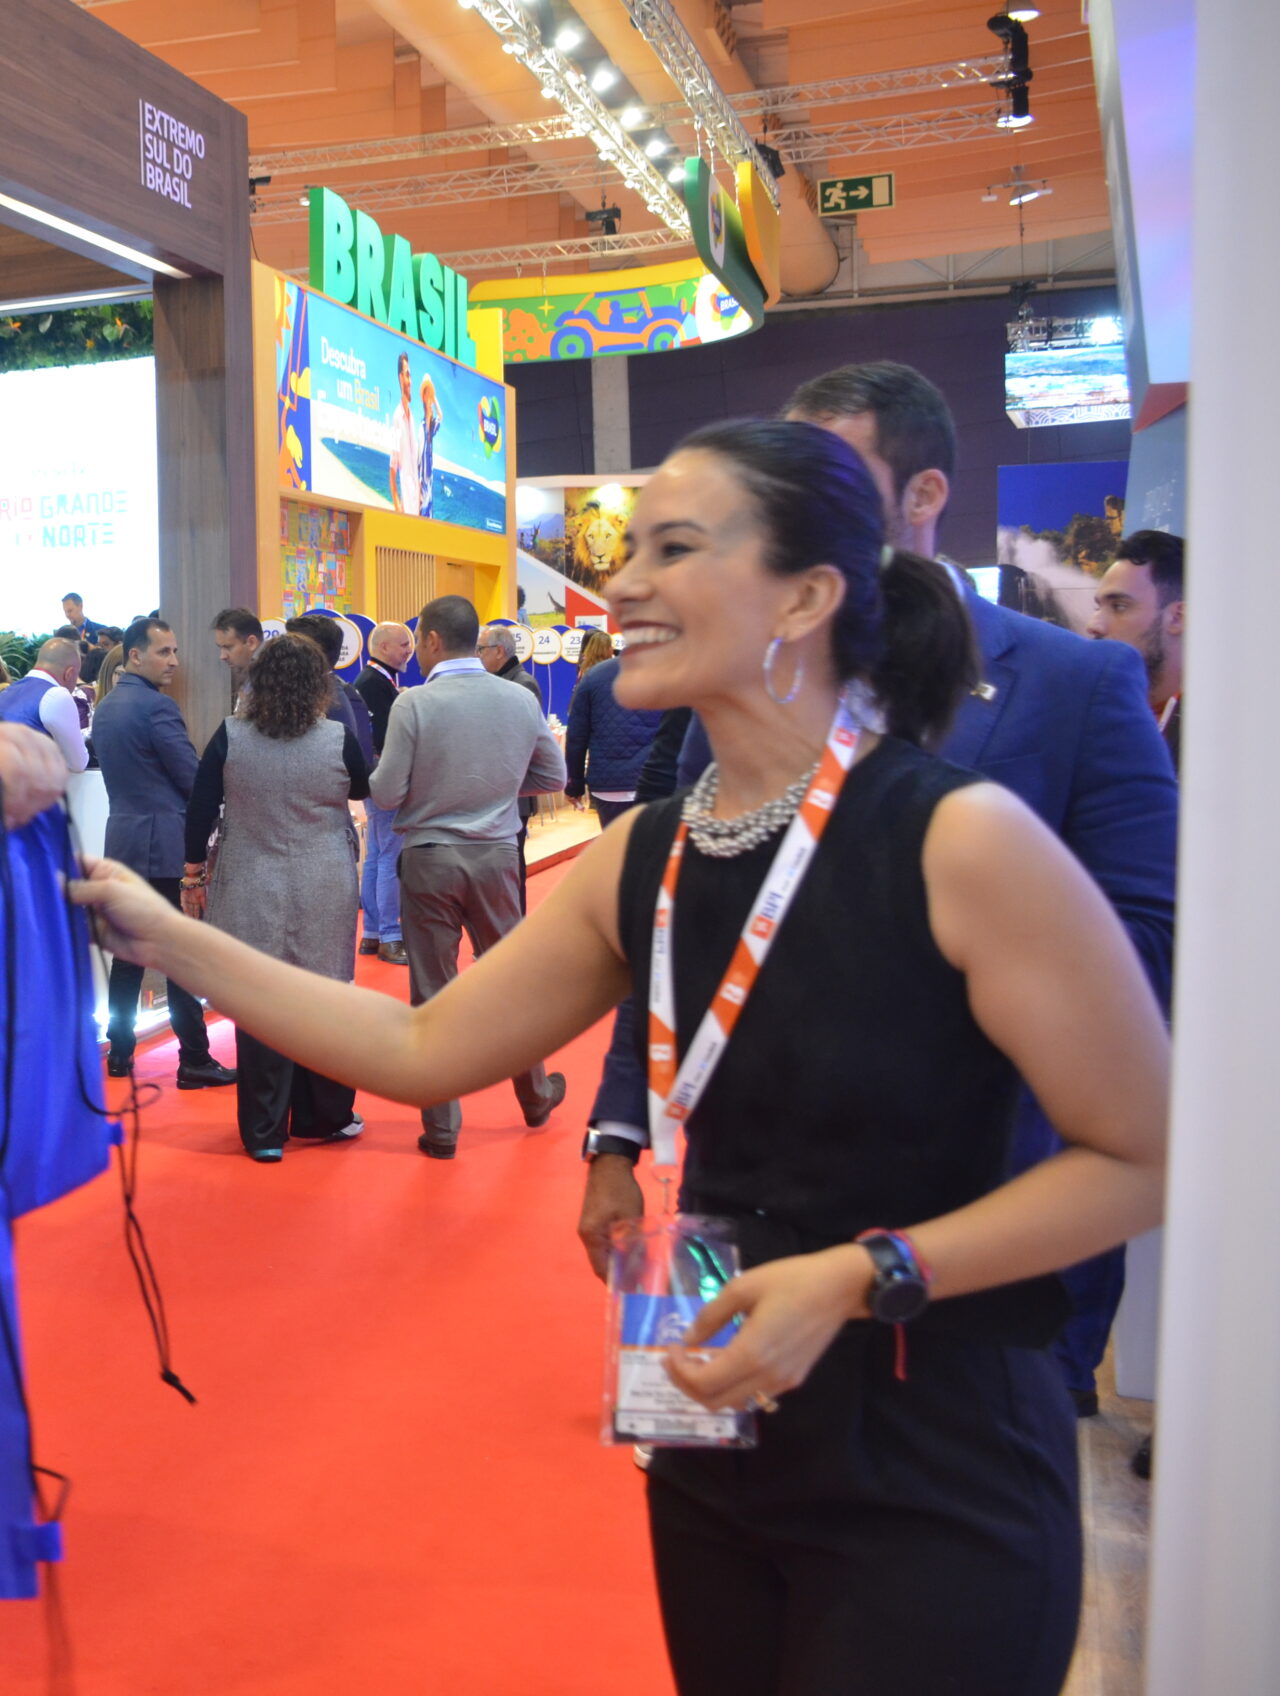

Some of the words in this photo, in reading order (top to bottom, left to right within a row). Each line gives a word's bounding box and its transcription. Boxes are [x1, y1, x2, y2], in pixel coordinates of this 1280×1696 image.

[144, 101, 206, 160] EXTREMO
[145, 132, 171, 170] SUL
[173, 147, 192, 180] DO
[146, 161, 192, 209] BRASIL
[309, 186, 476, 369] BRASIL
[320, 335, 367, 380] Descubra
[336, 379, 353, 402] um
[39, 489, 129, 520] GRANDE
[42, 521, 115, 549] NORTE
[538, 635, 551, 645] 24
[569, 635, 581, 645] 23
